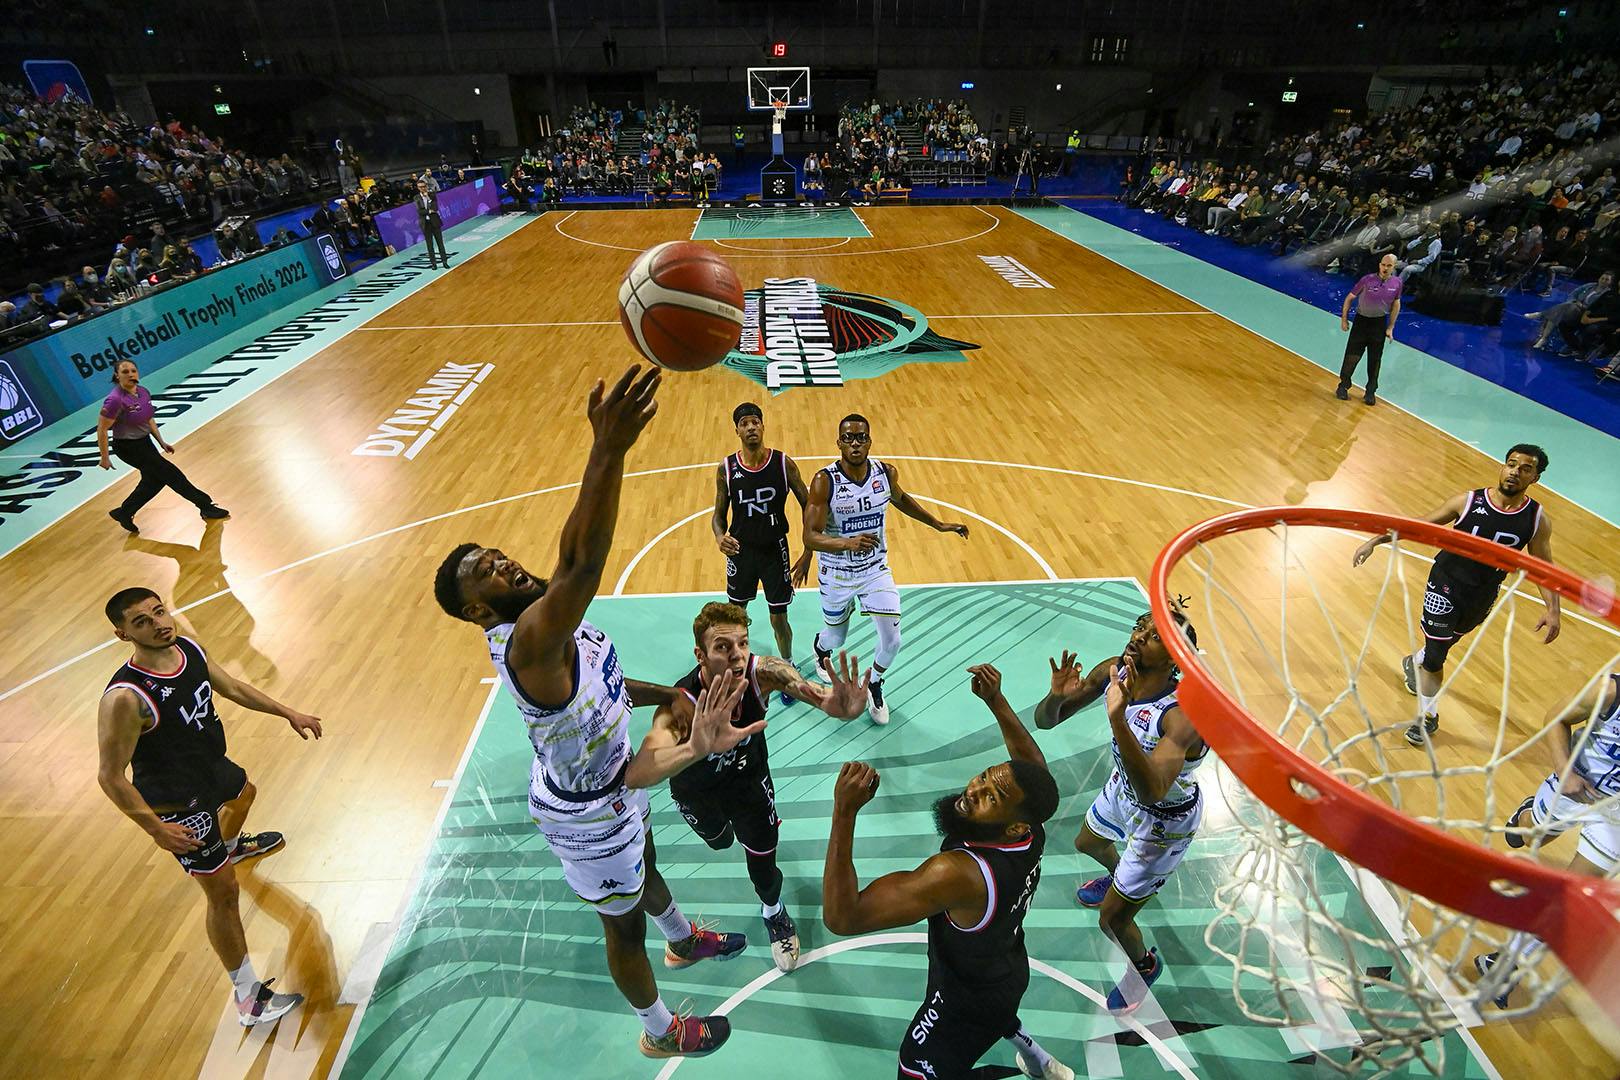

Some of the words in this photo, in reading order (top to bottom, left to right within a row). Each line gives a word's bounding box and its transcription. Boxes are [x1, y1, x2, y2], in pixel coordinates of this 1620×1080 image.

[774, 44, 785, 56] 19
[763, 277, 825, 314] FINALS
[70, 312, 181, 380] Basketball
[178, 293, 237, 326] Trophy
[234, 276, 277, 305] Finals
[275, 260, 308, 290] 2022
[212, 308, 360, 366] TROPHY
[325, 272, 422, 304] FINALS
[765, 316, 844, 388] TROPHY
[2, 406, 36, 432] BBL
[350, 361, 484, 457] DYNAMIK
[845, 516, 882, 532] PHOENIX
[856, 496, 872, 513] 15
[779, 538, 792, 583] LIONS
[911, 990, 944, 1045] LONS
